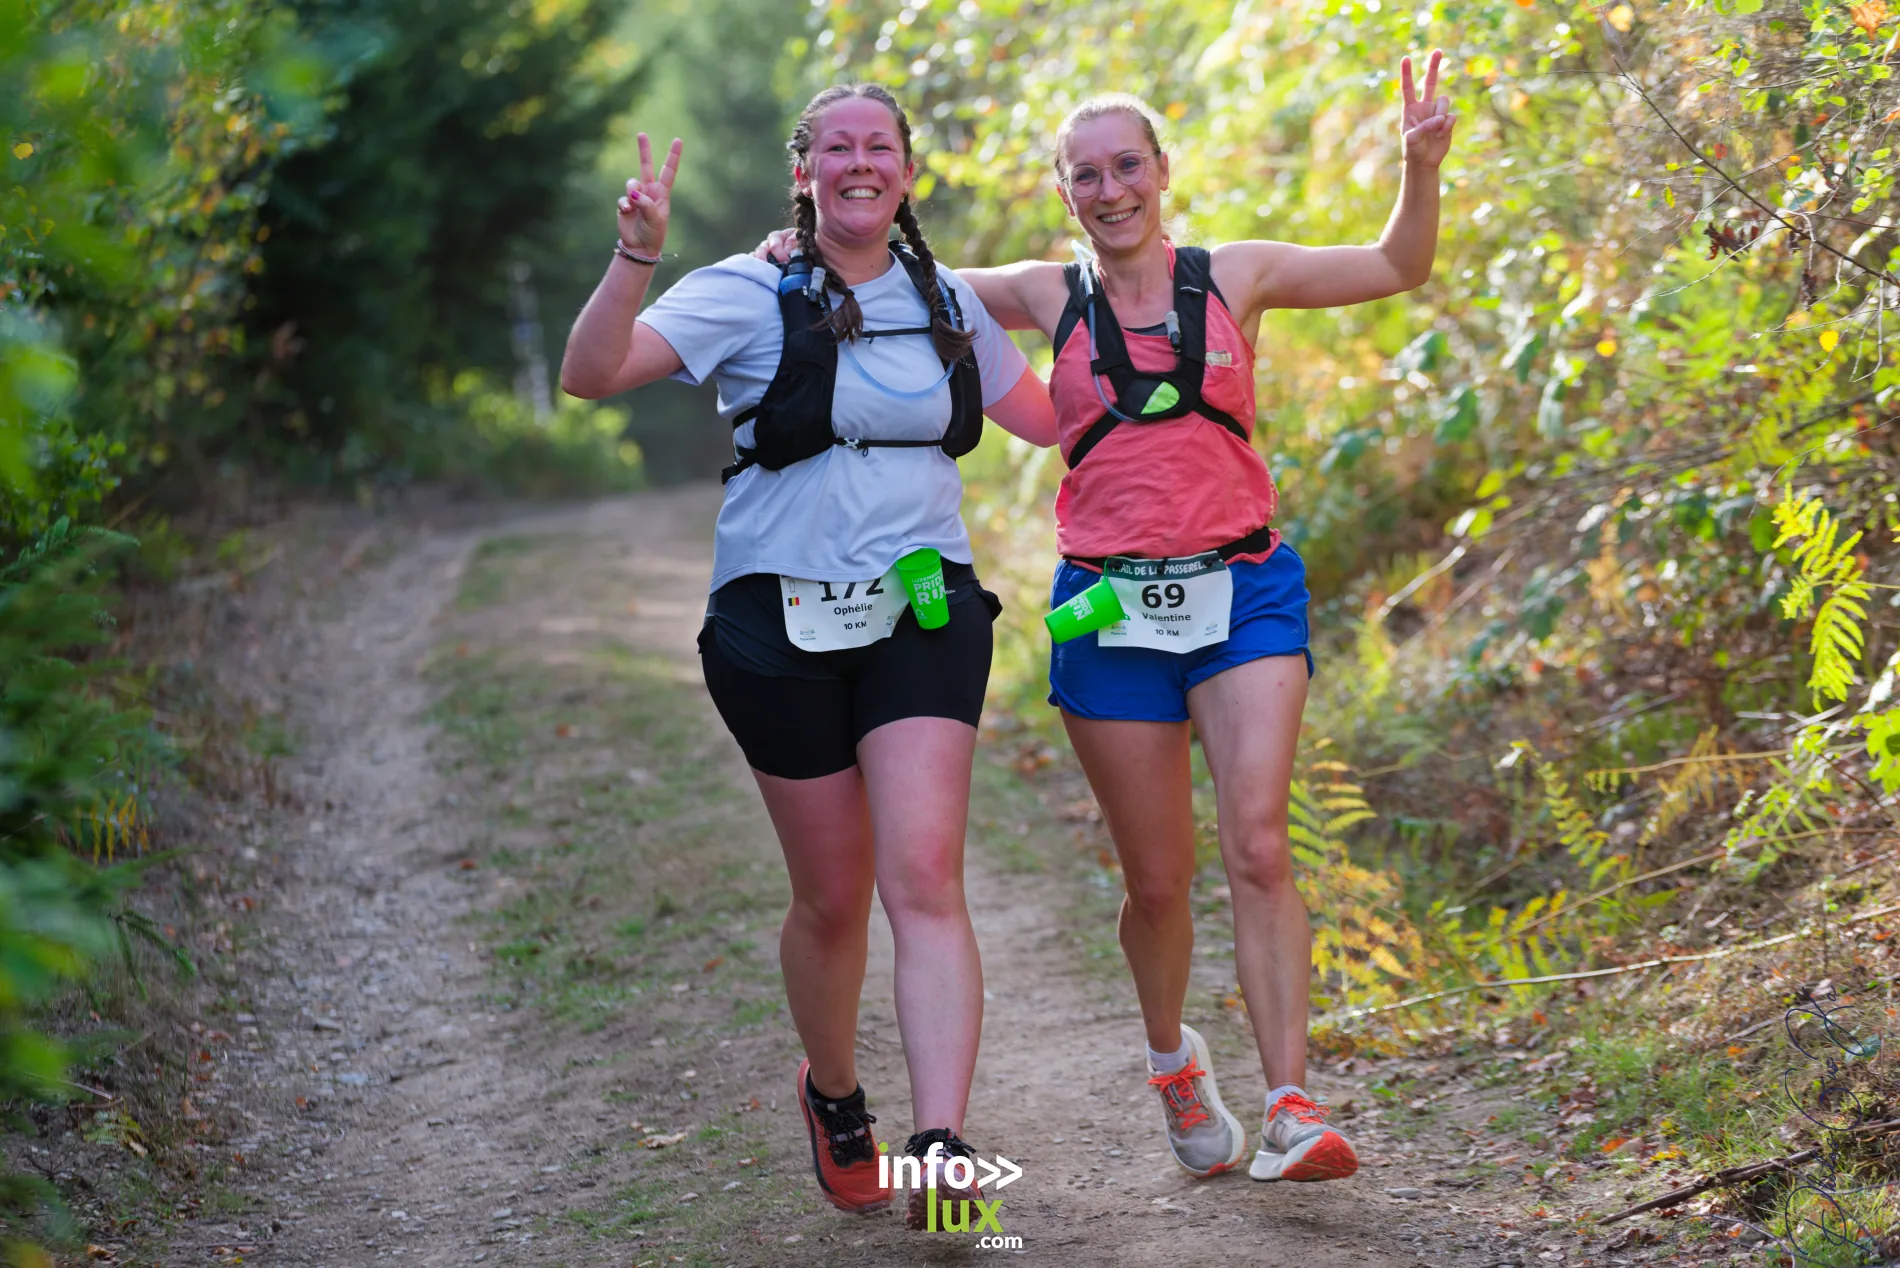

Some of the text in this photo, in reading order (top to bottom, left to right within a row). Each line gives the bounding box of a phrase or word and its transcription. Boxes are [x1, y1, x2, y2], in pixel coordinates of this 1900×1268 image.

[1134, 566, 1147, 576] DE
[1164, 561, 1208, 575] PASSEREL
[914, 575, 944, 592] PRID
[1141, 583, 1186, 609] 69
[833, 603, 873, 616] Ophélie
[1142, 611, 1192, 622] Valentine
[844, 621, 868, 631] 10 KM
[1155, 628, 1180, 637] 10 KM
